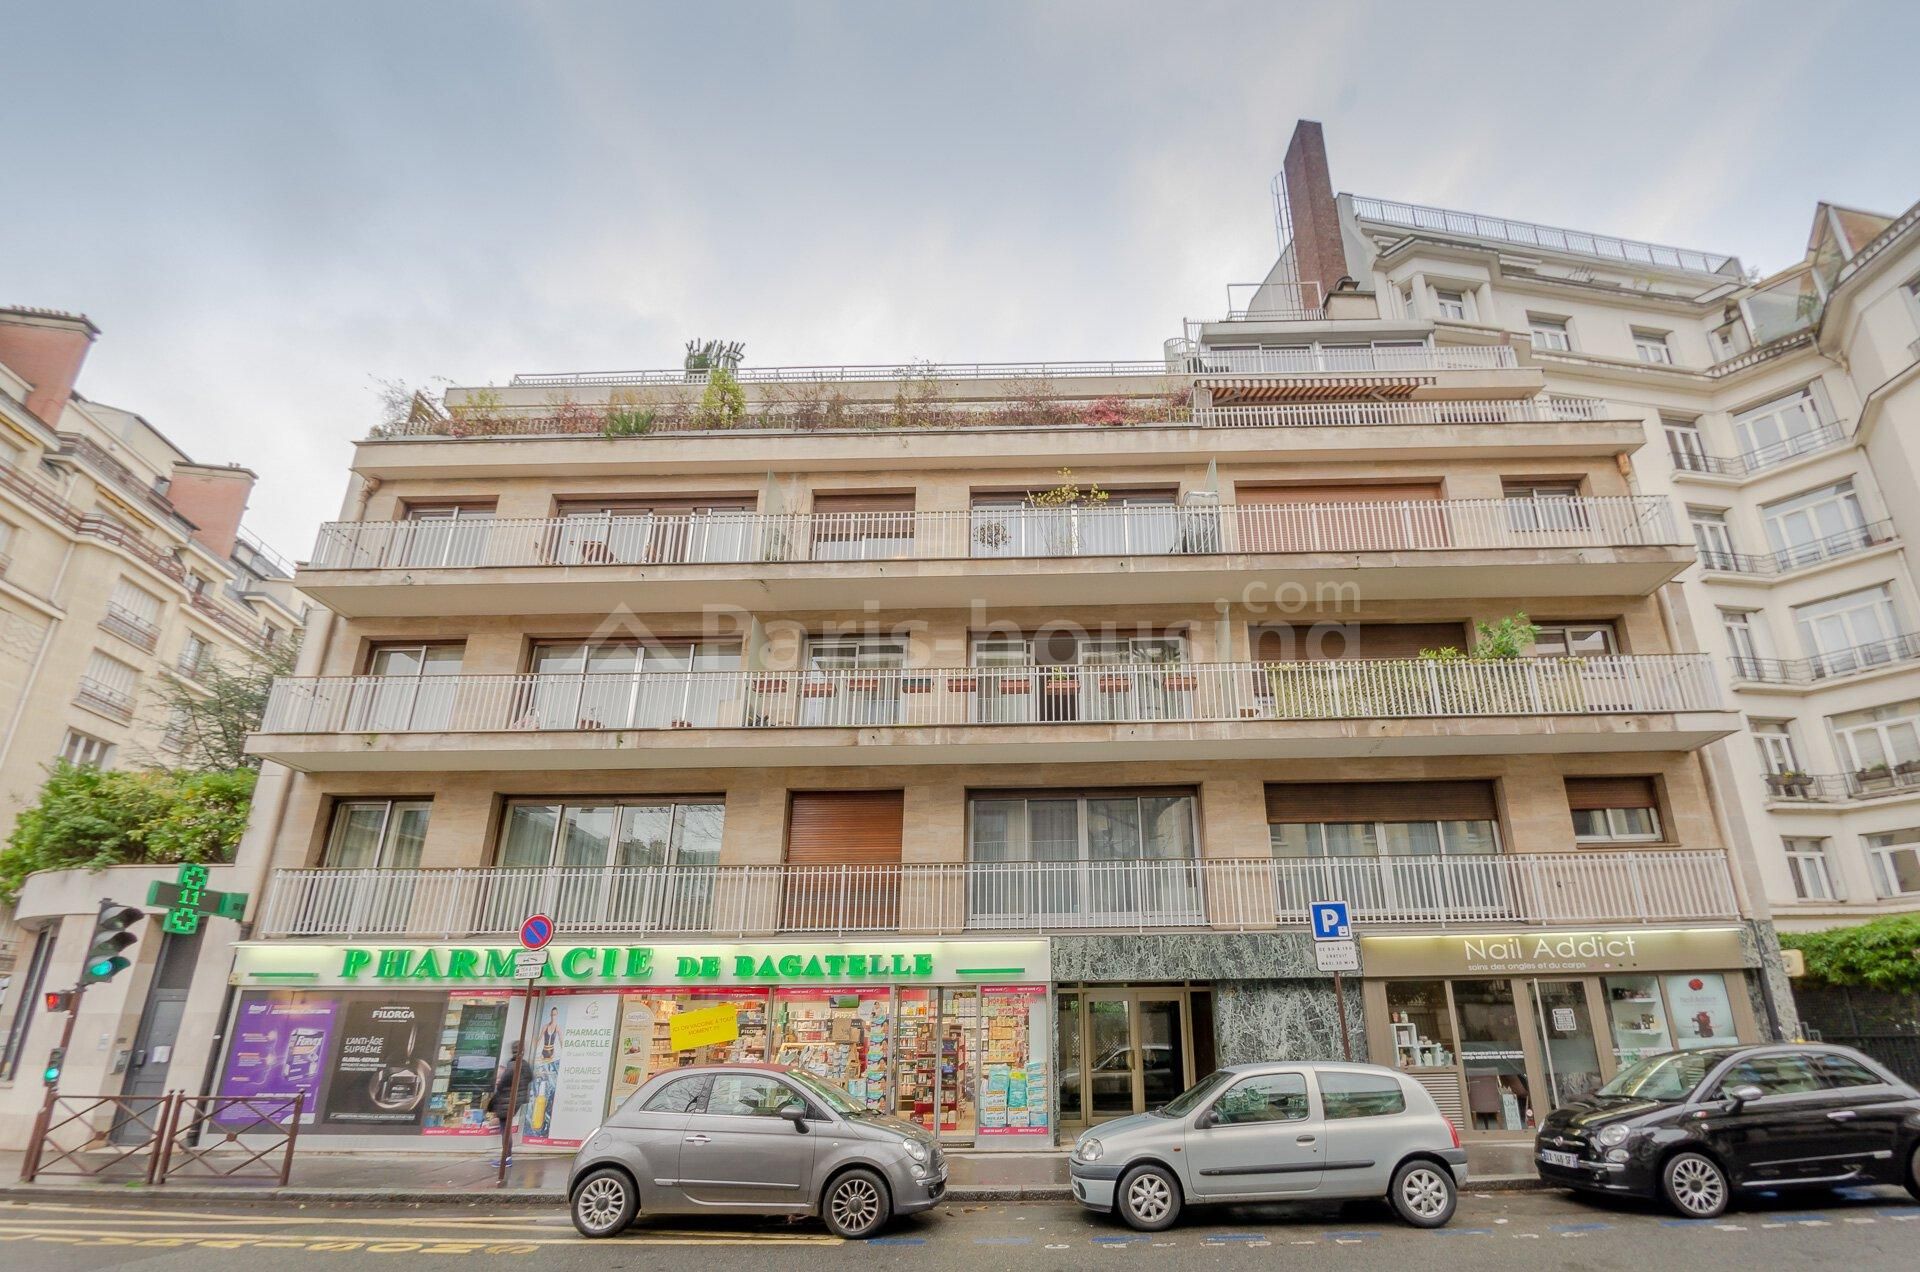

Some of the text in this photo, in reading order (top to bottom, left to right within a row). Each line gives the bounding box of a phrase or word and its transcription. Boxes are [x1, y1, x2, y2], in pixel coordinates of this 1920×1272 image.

[1321, 909, 1339, 933] P
[1464, 935, 1636, 961] Nail Addict
[675, 956, 721, 978] DE
[733, 953, 933, 978] BAGATELLE
[1468, 961, 1586, 971] soins des ongles et du corps
[372, 1010, 415, 1019] FILORGA
[565, 1028, 612, 1036] PHARMACIE
[564, 1039, 610, 1048] BAGATELLE
[343, 1045, 382, 1054] SUPRÊME
[564, 1066, 602, 1075] HORAIRES
